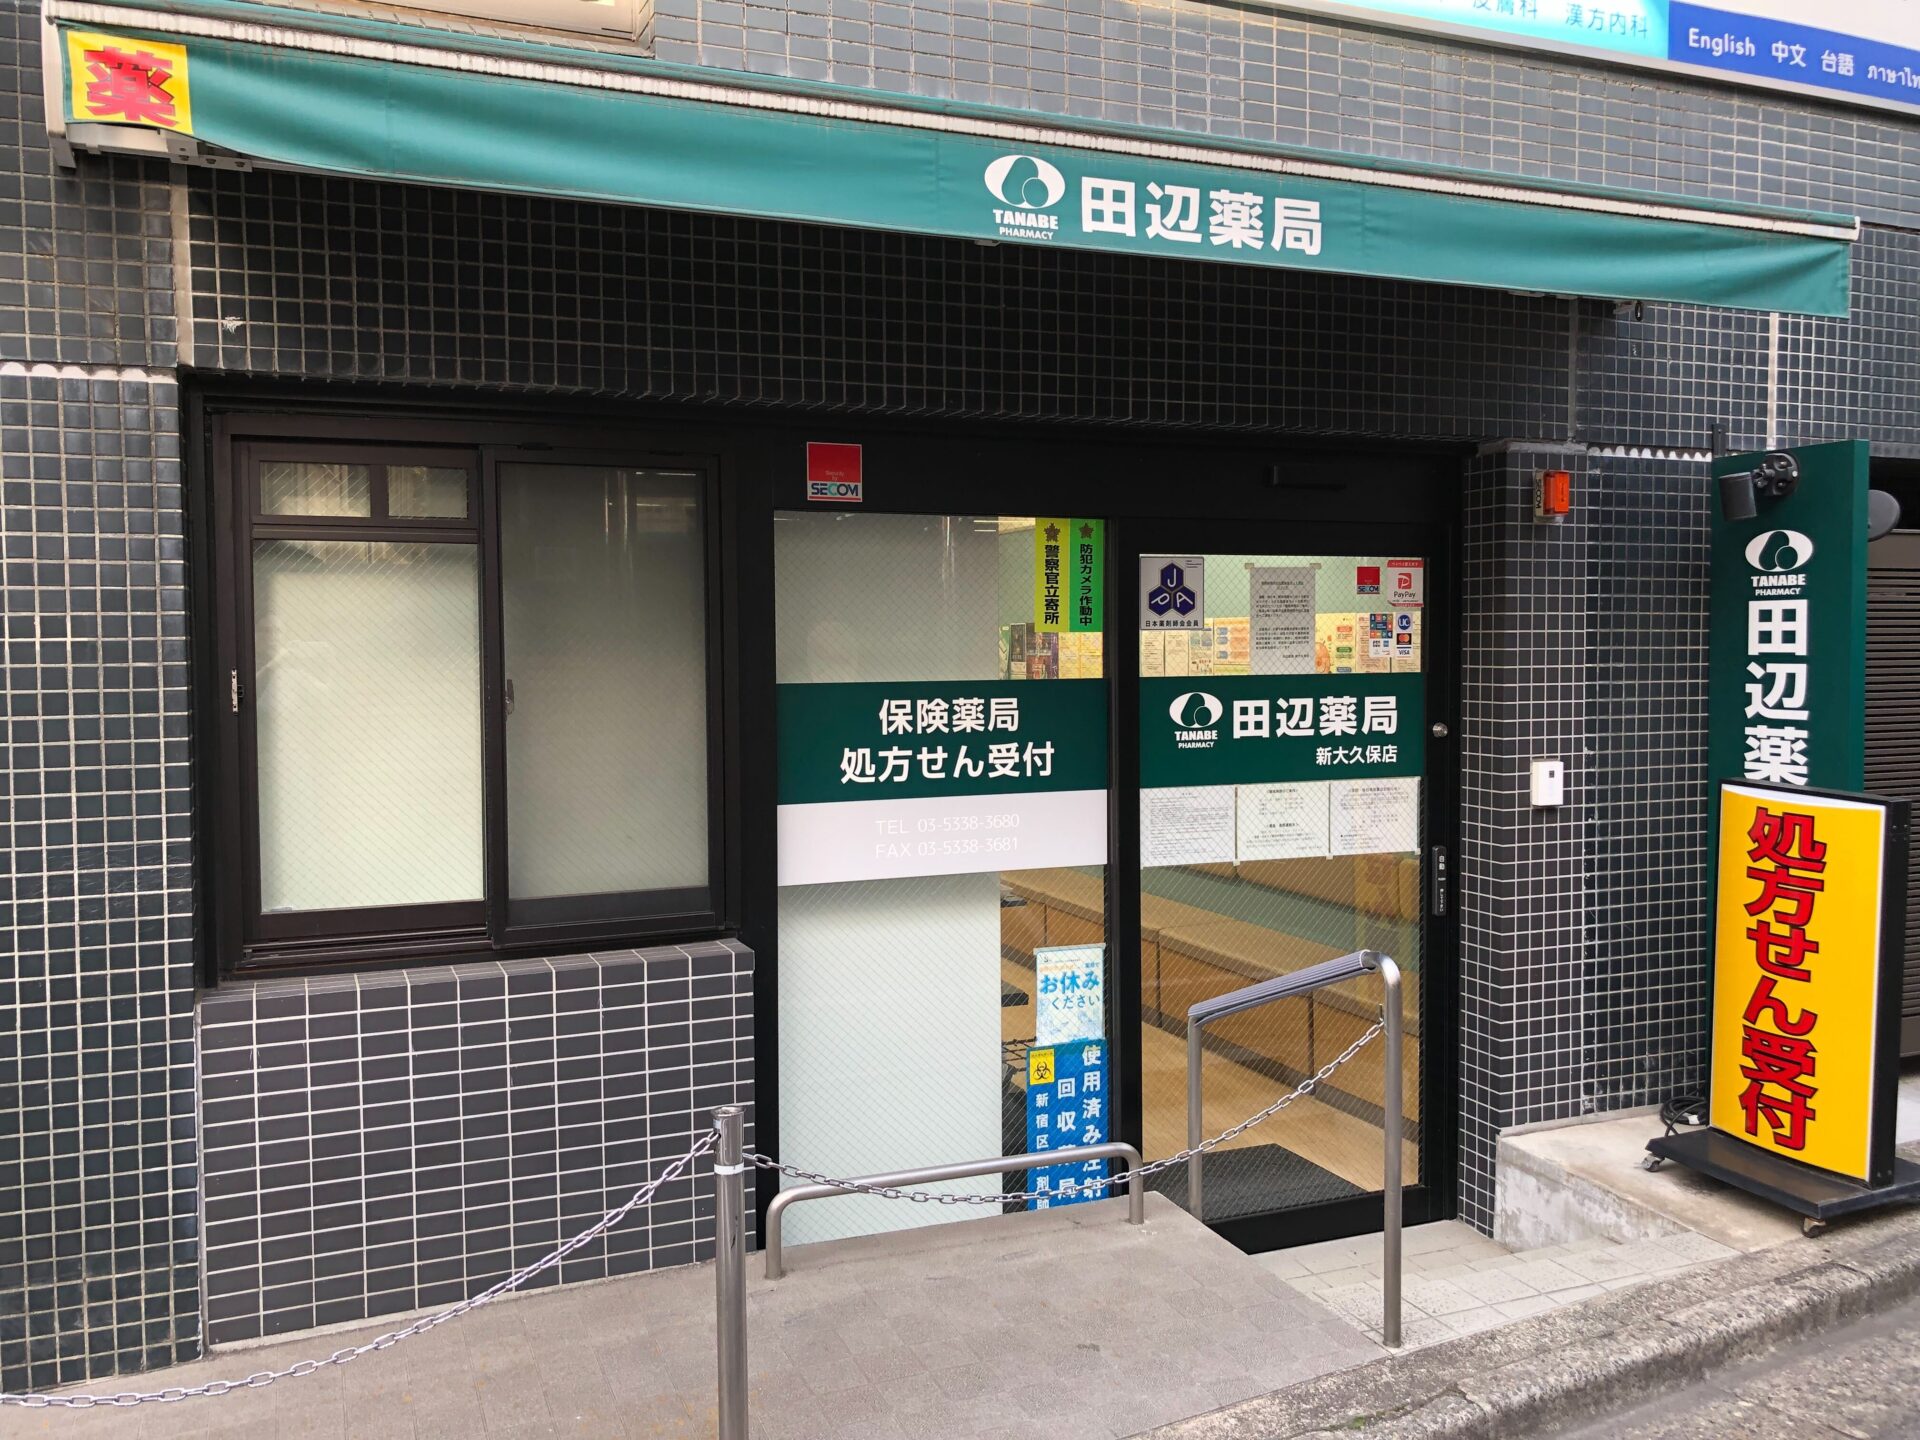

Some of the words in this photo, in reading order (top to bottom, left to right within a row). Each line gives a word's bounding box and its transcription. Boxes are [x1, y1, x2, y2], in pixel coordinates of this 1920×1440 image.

[1566, 3, 1648, 39] 漢方内科
[1688, 28, 1756, 57] English
[1771, 40, 1807, 68] 中文
[1821, 49, 1855, 77] 台語
[83, 46, 179, 127] 薬
[993, 209, 1059, 231] TANABE
[1081, 176, 1323, 256] 田辺薬局
[999, 227, 1055, 240] PHARMACY
[811, 483, 859, 496] SECOM
[1044, 544, 1060, 625] 警察官立寄所
[1079, 543, 1093, 627] 防犯カメラ作動中
[1751, 574, 1806, 587] TANABE
[1755, 587, 1801, 596] PHARMACY
[1393, 591, 1416, 599] PayPay
[1398, 618, 1410, 627] UC
[1744, 599, 1810, 786] 田辺薬
[878, 697, 1019, 735] 保険薬局
[1232, 695, 1398, 739] 田辺薬局
[1174, 730, 1218, 742] TANABE
[1178, 741, 1215, 749] PHARMACY
[840, 741, 1055, 785] 処方せん受付
[1316, 744, 1398, 766] 新大久保店
[875, 819, 910, 835] TEL
[917, 813, 1020, 833] 03-5338-3680
[875, 843, 911, 859] FAX
[917, 837, 1018, 857] 03-5338-3681
[1039, 970, 1100, 994] お休み
[1738, 806, 1827, 1151] 処方せん受付
[1051, 994, 1100, 1010] ください
